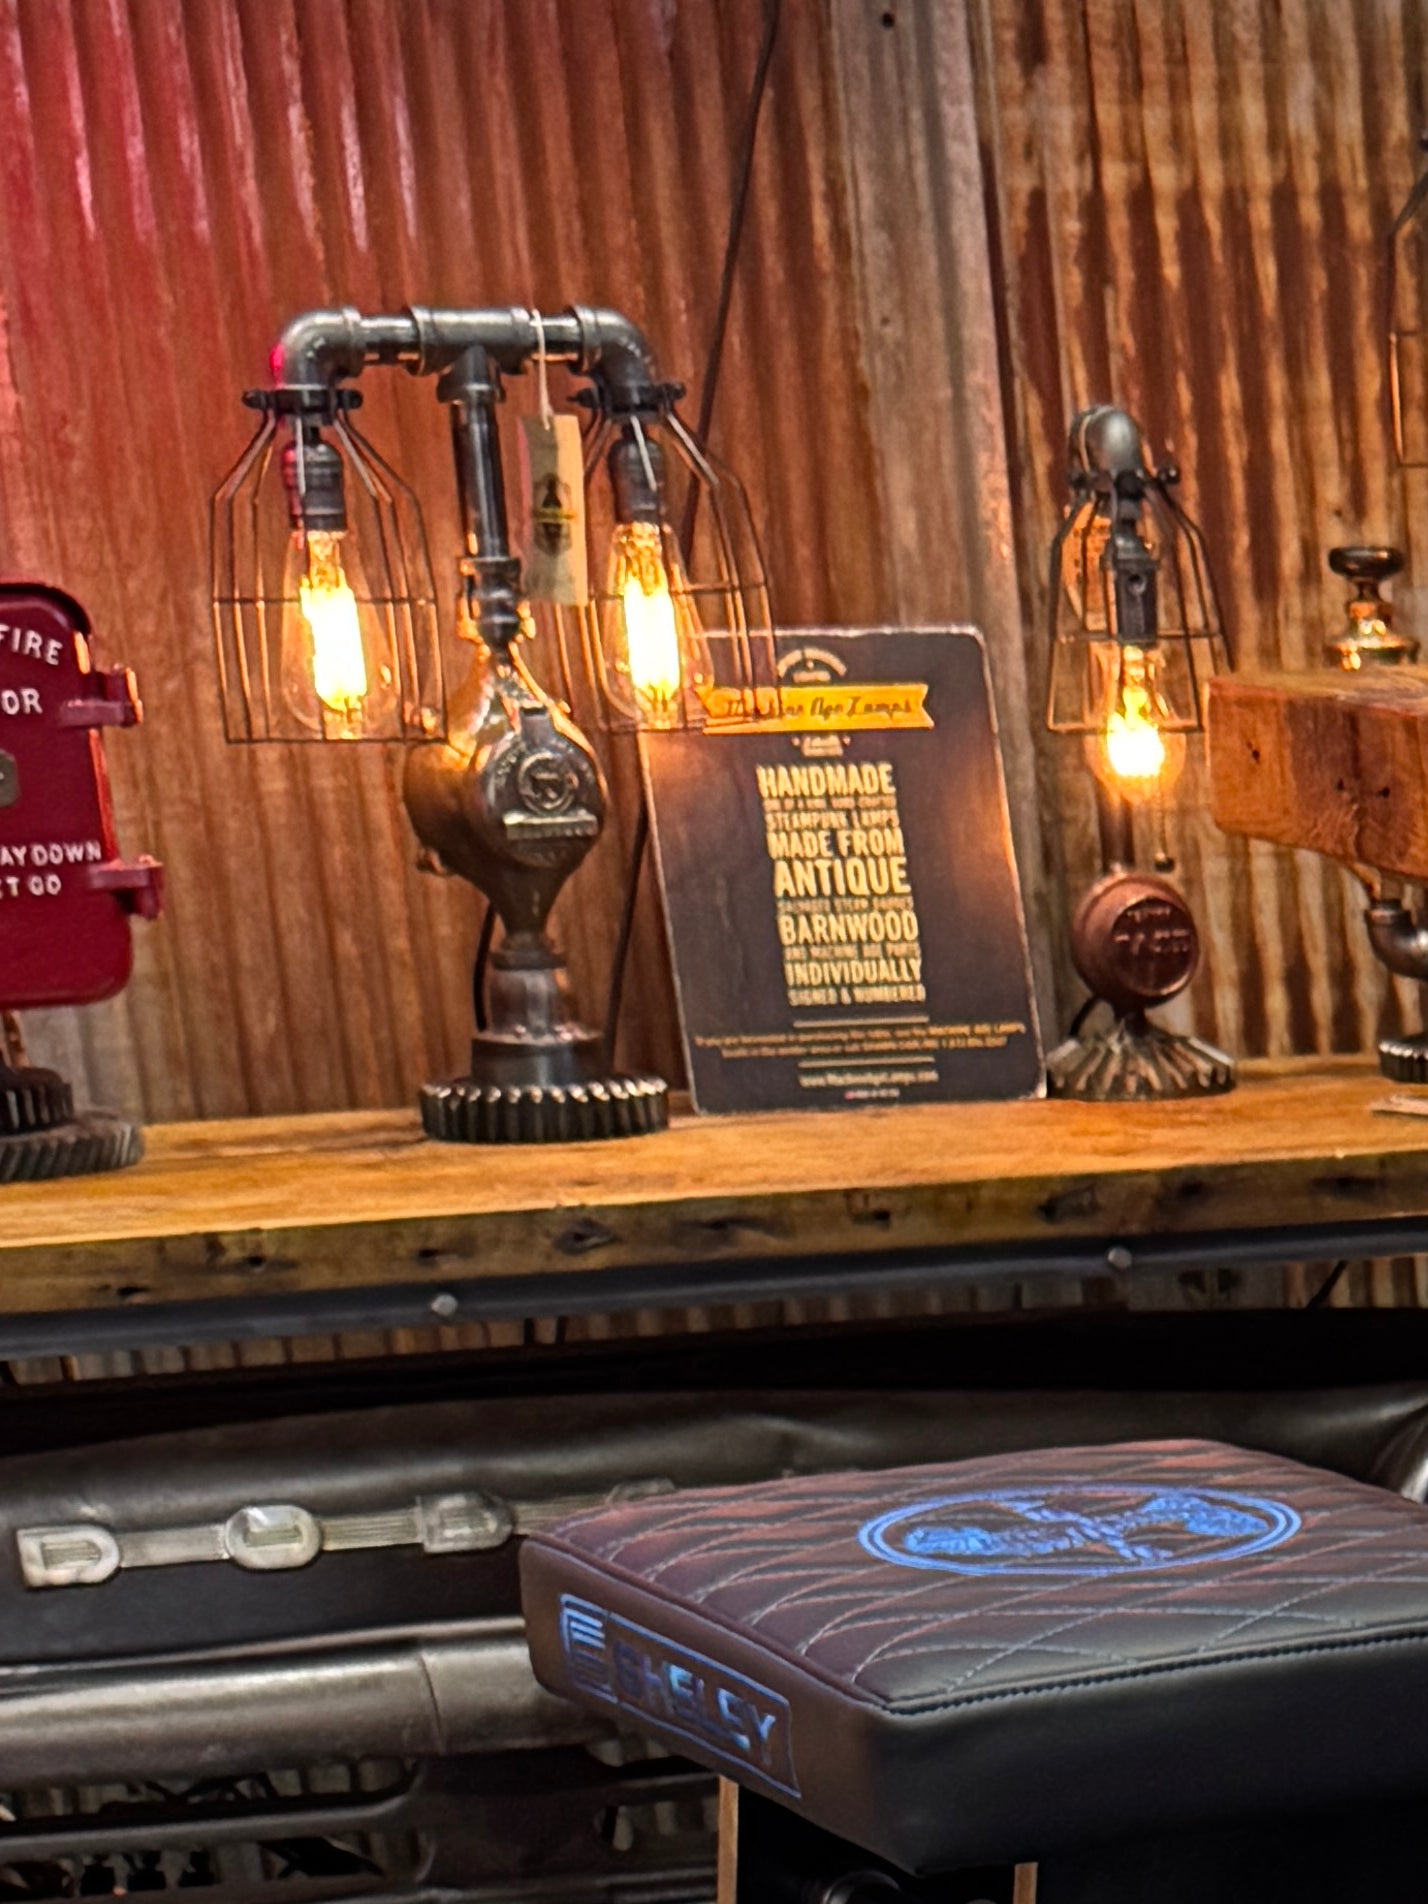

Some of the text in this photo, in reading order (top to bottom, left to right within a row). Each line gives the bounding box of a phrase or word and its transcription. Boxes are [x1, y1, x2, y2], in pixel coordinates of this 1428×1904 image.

[756, 762, 896, 798] HANDMADE
[30, 841, 102, 867] DOWN
[766, 827, 905, 860] MADE FROM
[774, 856, 912, 898] ANTIQUE
[776, 910, 919, 946] BARNWOOD
[784, 957, 922, 986] INDIVIDUALLY
